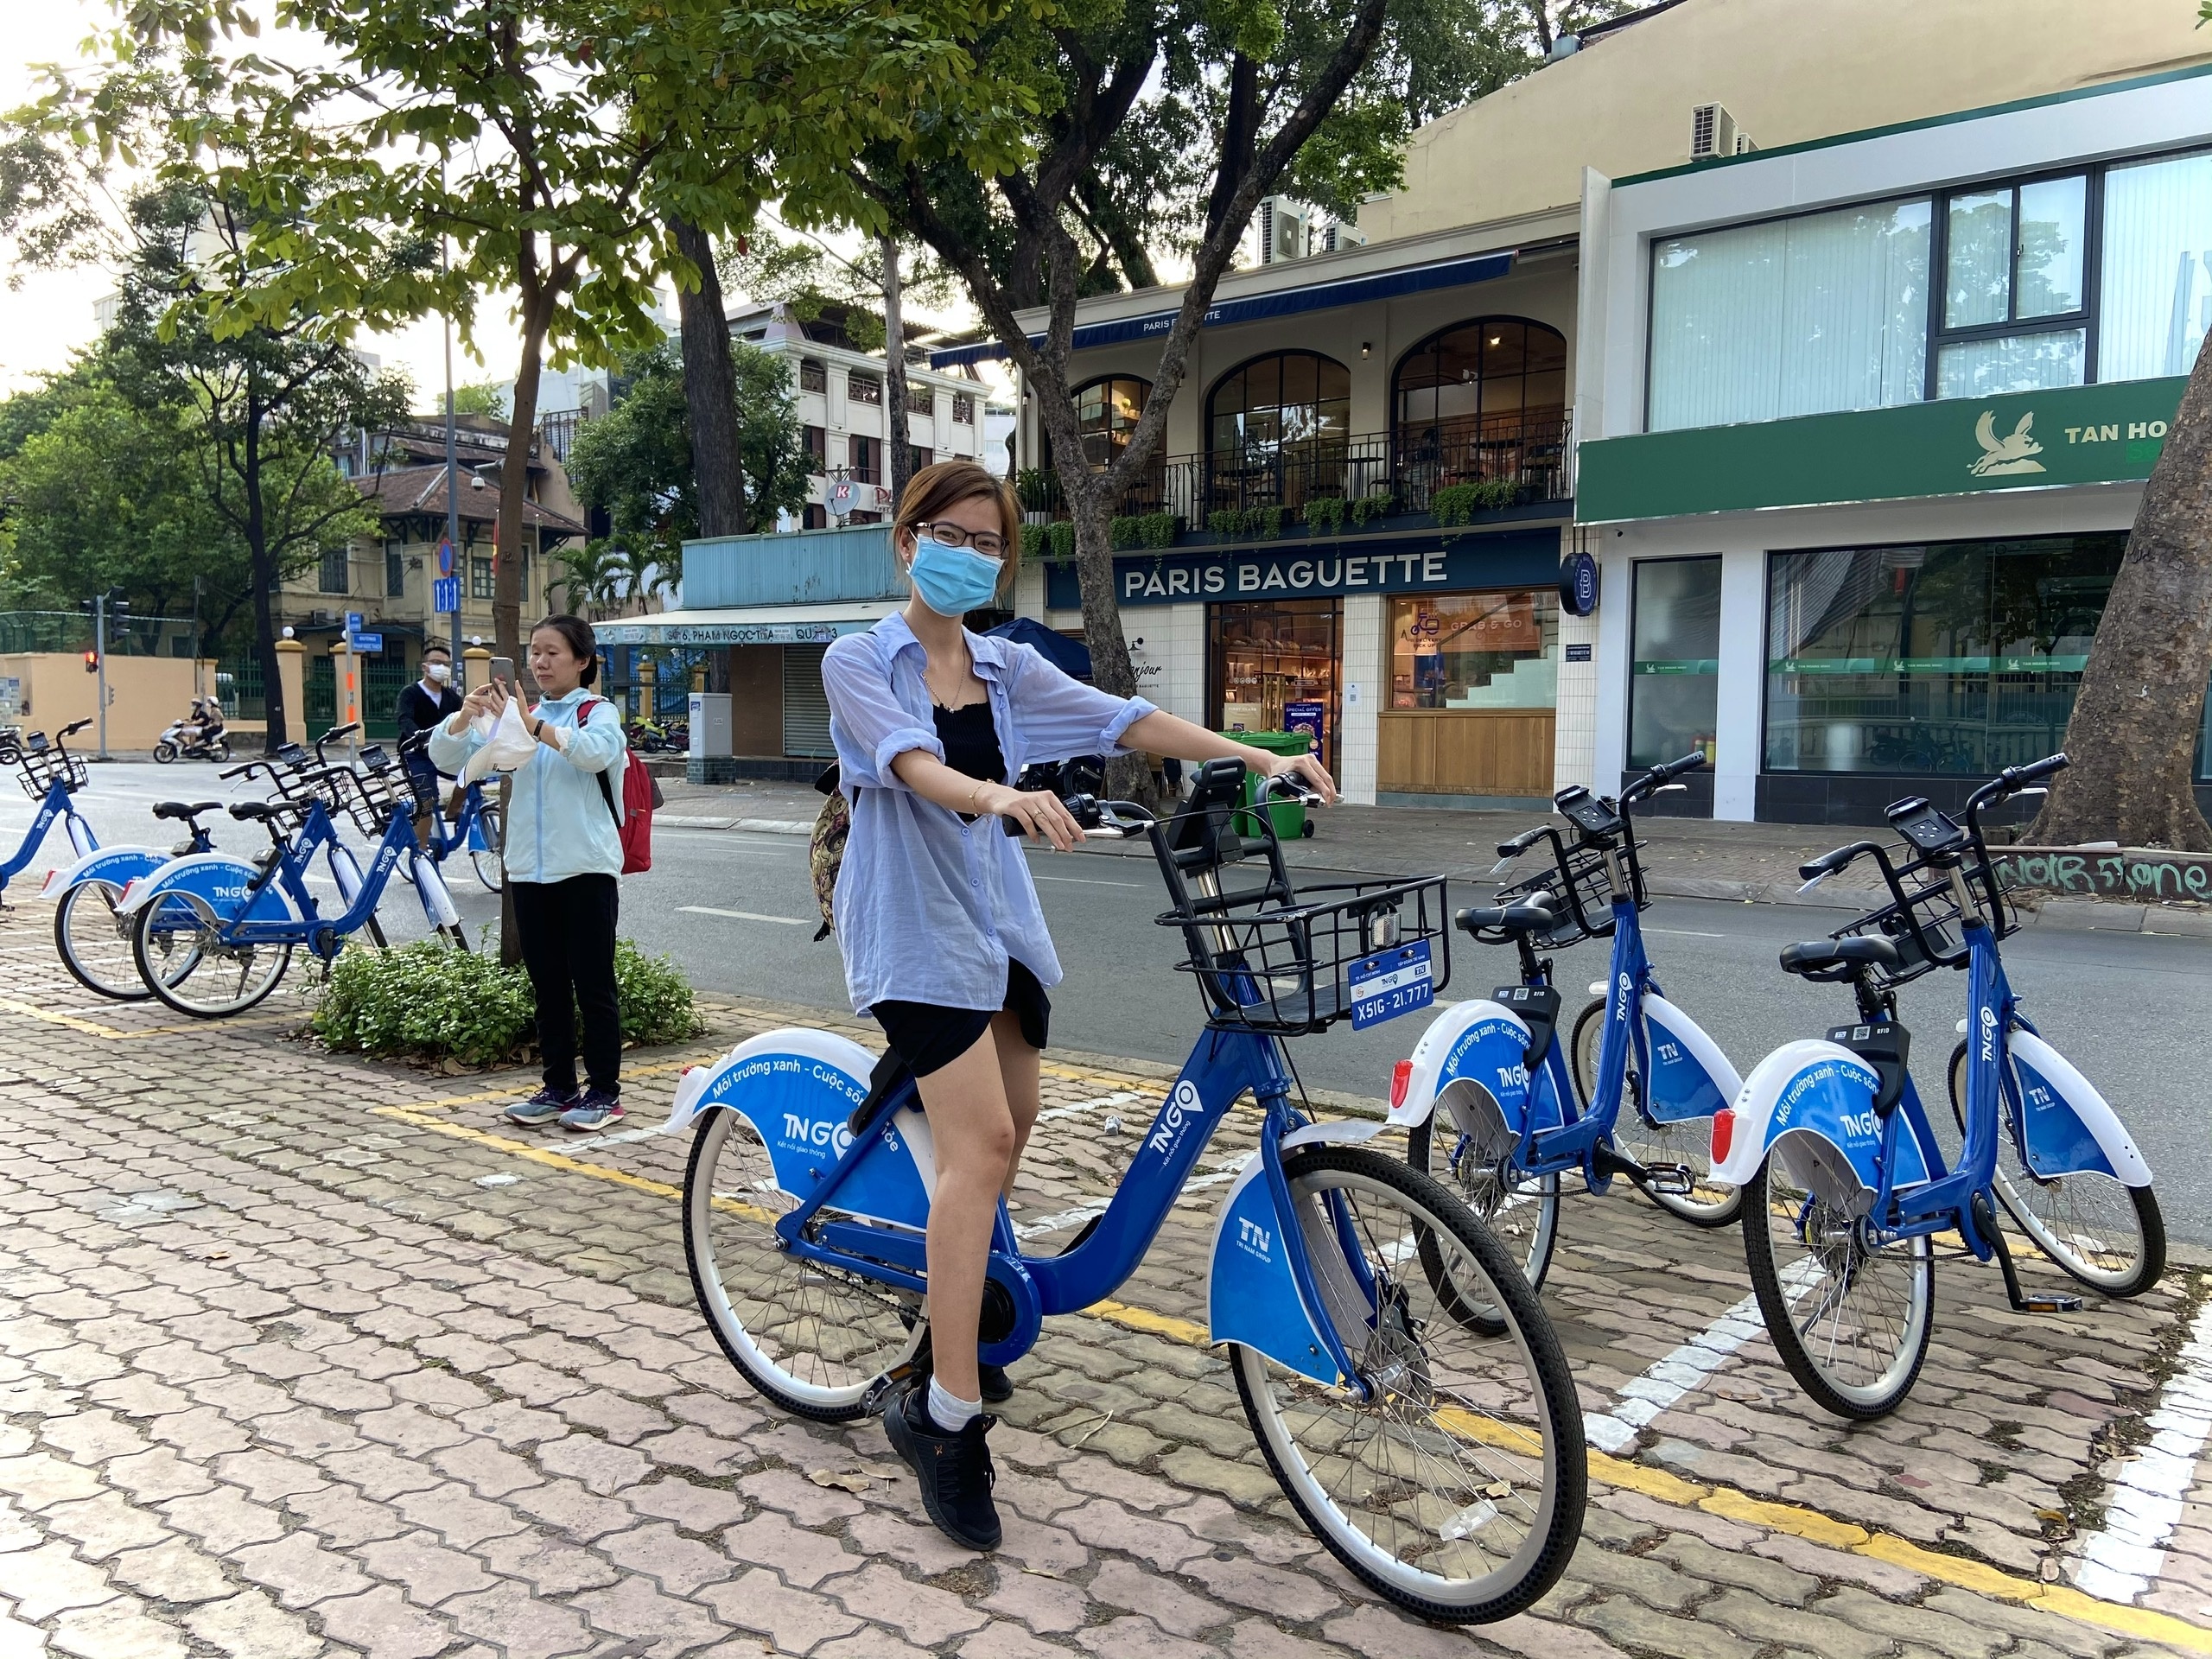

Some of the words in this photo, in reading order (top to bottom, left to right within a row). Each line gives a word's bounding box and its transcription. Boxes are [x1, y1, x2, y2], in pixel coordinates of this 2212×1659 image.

[1143, 320, 1169, 331] PARIS
[2064, 423, 2119, 444] TAN
[1125, 565, 1225, 598] PARIS
[1238, 551, 1447, 592] BAGUETTE
[1490, 620, 1499, 630] &
[1503, 620, 1522, 629] GO
[225, 865, 244, 876] Cuộc
[1446, 1052, 1460, 1077] Môi
[1456, 1031, 1480, 1058] trường
[1479, 1022, 1496, 1038] xanh
[1501, 1022, 1517, 1039] Cuộc
[713, 1075, 733, 1099] Môi
[733, 1059, 771, 1083] trường
[772, 1058, 801, 1073] xanh
[812, 1065, 845, 1092] Cuộc
[1776, 1098, 1792, 1127] Môi
[1787, 1074, 1815, 1105] trường
[1813, 1064, 1835, 1081] xanh
[1840, 1064, 1863, 1084] Cuộc
[1149, 1079, 1204, 1154] TNGO
[1238, 1216, 1271, 1253] TN
[1244, 1244, 1255, 1255] NAM
[1255, 1250, 1272, 1264] GROUP
